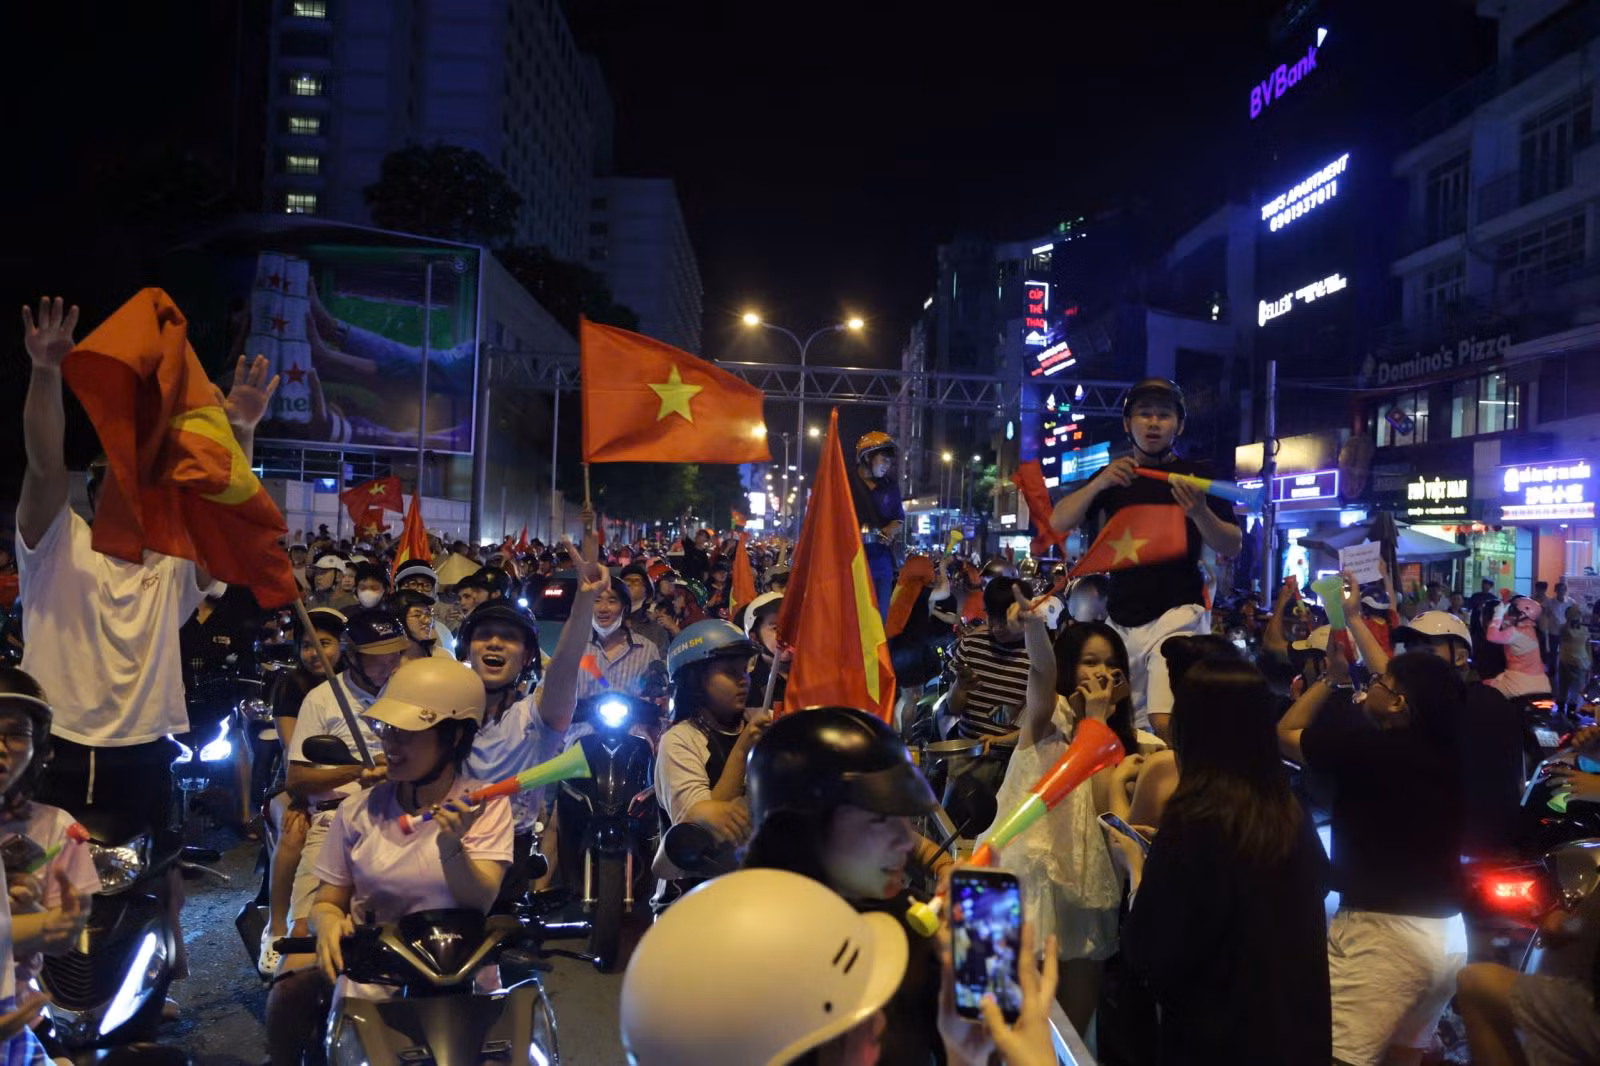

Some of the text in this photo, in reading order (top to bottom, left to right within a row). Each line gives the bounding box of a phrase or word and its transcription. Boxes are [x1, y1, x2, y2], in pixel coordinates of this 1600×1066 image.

[1250, 44, 1318, 119] BVBank
[1378, 333, 1511, 384] Domino's Pizza
